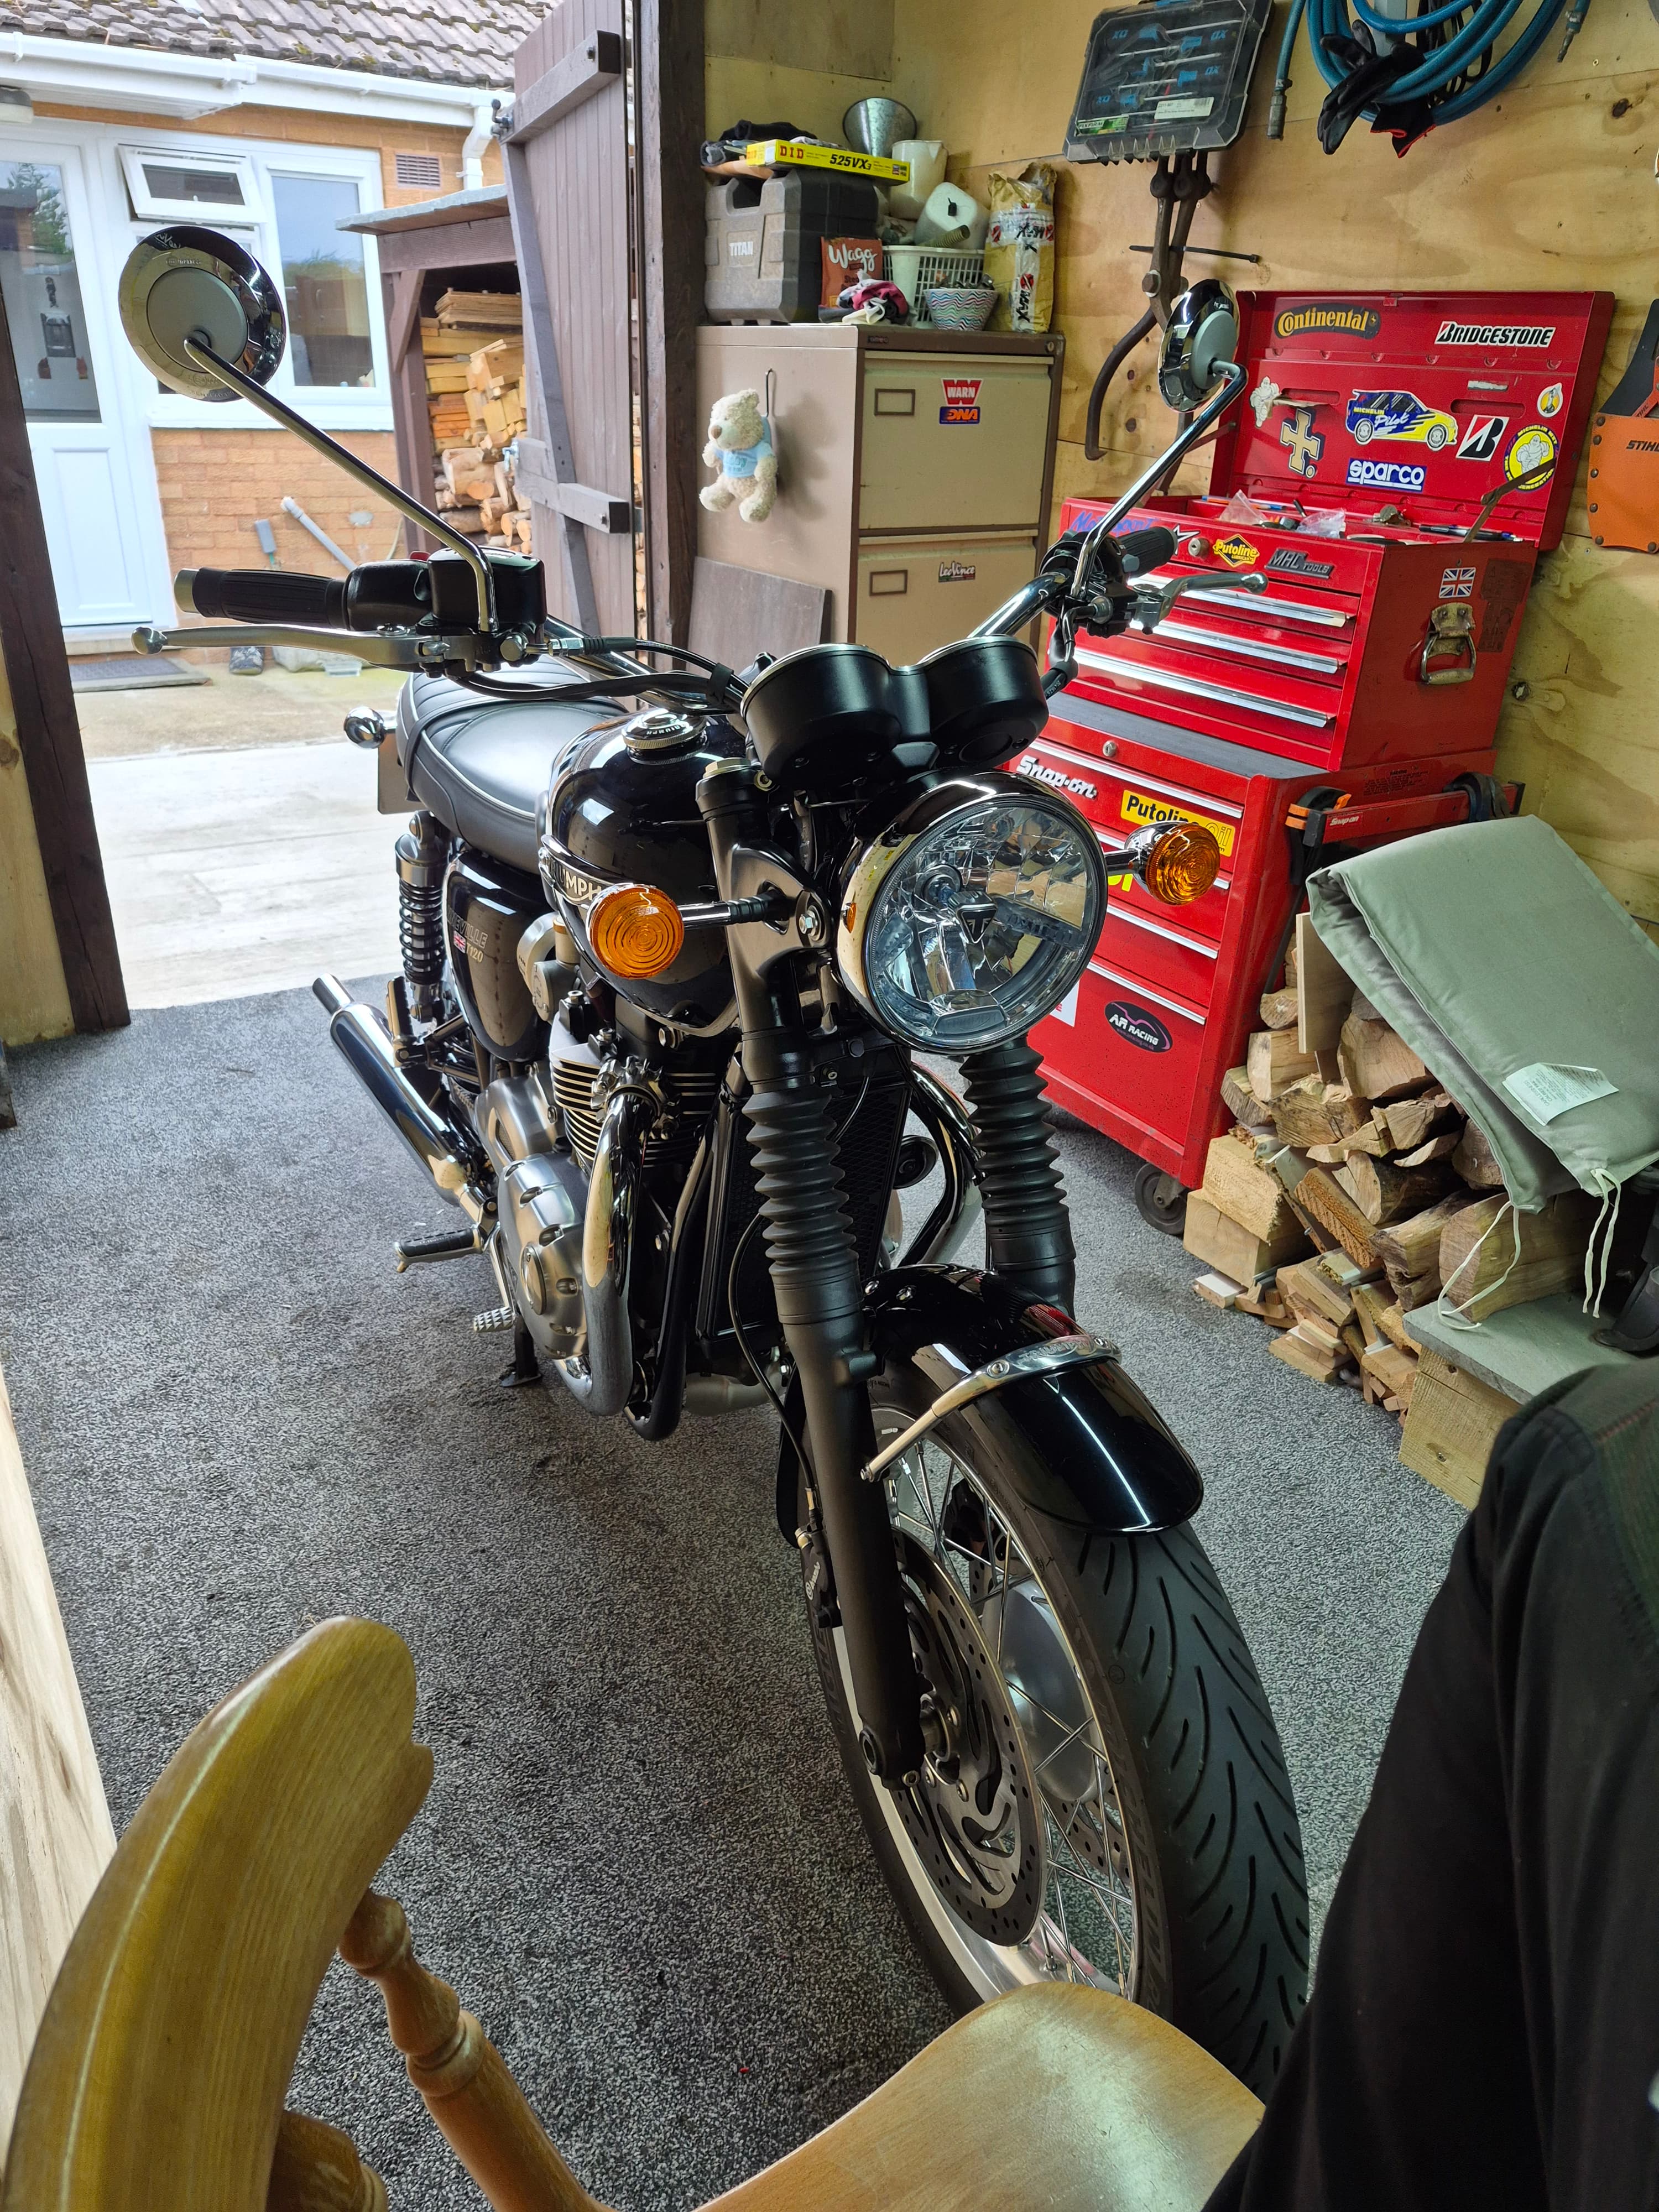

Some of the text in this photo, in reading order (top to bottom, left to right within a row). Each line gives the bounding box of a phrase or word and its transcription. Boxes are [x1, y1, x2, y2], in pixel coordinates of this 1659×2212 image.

[780, 145, 804, 159] DID
[729, 241, 754, 257] TITAN
[828, 243, 878, 274] Wagg
[1277, 306, 1369, 337] Continental
[1437, 321, 1553, 345] BRIDGESTONE
[947, 387, 975, 398] WARN
[1353, 406, 1385, 415] MICHELIN
[1374, 411, 1411, 428] Pilot
[1517, 425, 1548, 437] MICHELIN
[1349, 460, 1425, 485] sparco
[1213, 540, 1258, 558] Putoline
[1270, 550, 1330, 574] MAC TOOLS
[1125, 795, 1199, 824] Putolin
[466, 942, 484, 963] T120
[1128, 1025, 1159, 1046] RACING
